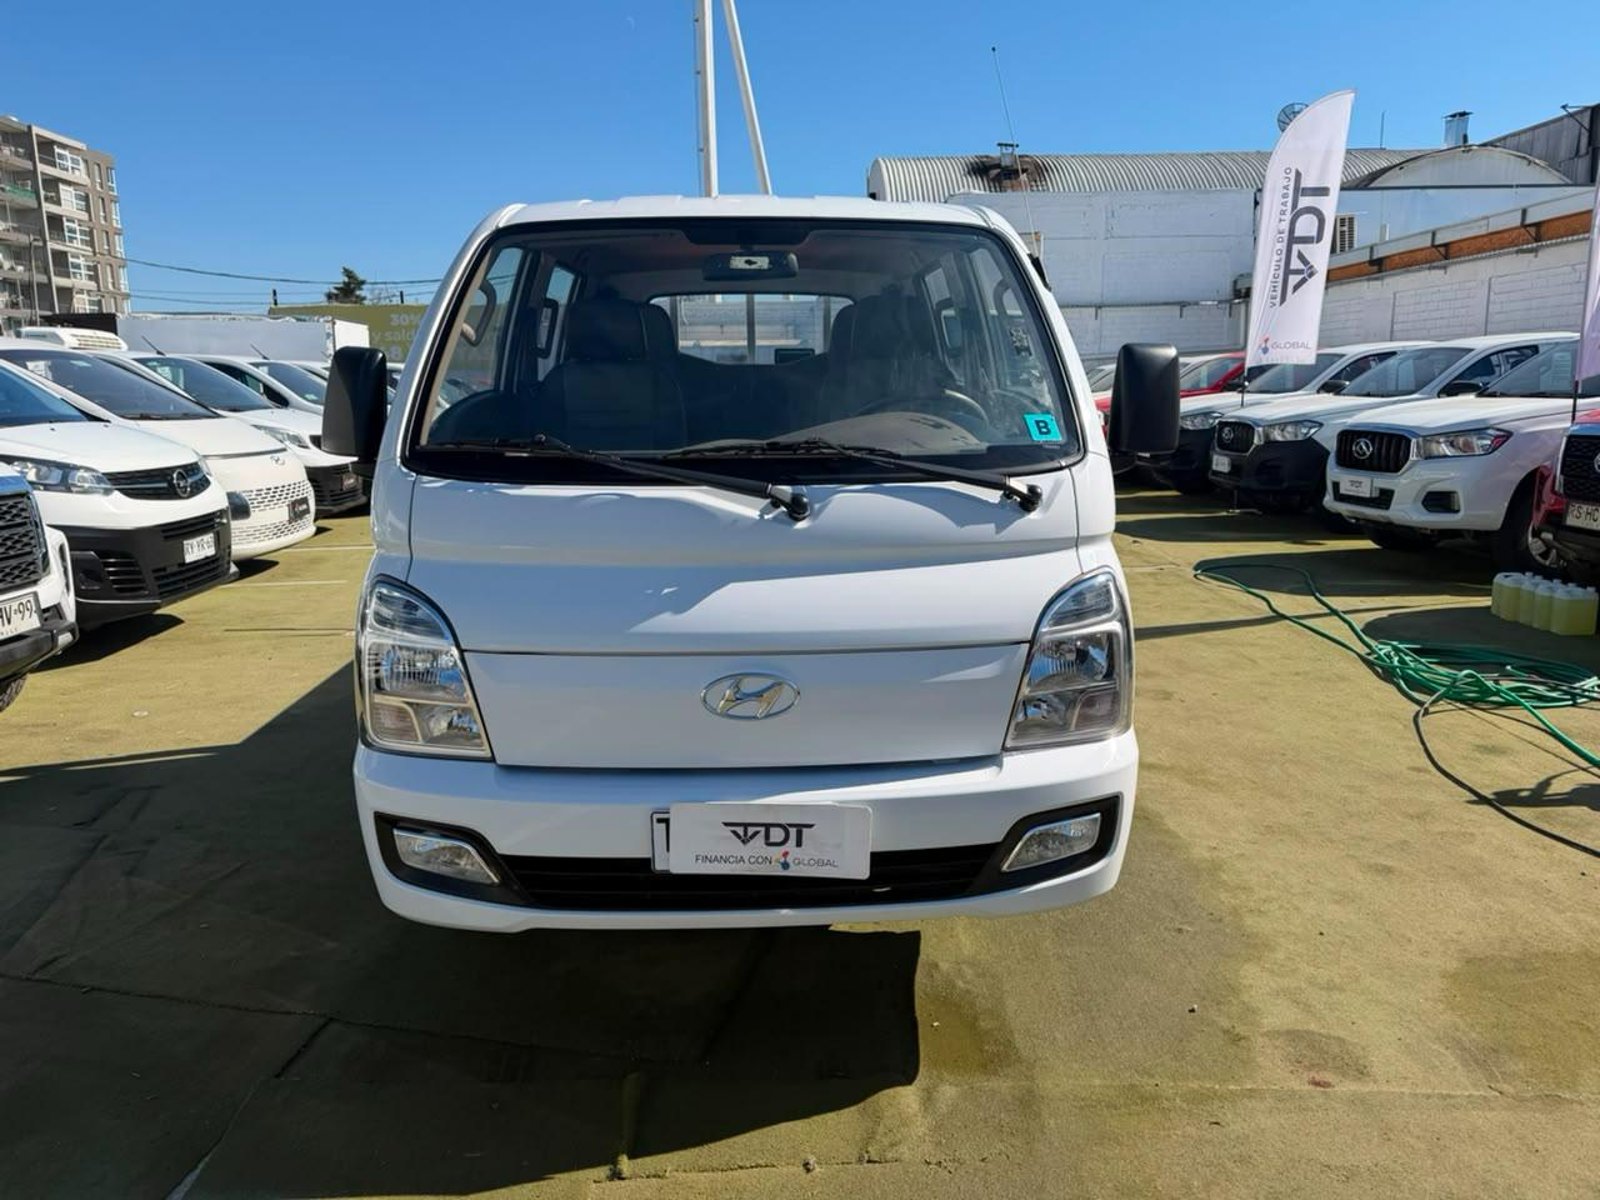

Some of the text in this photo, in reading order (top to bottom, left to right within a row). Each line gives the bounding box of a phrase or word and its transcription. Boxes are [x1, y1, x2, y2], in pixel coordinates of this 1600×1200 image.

[1269, 166, 1292, 308] VEHÍCULO DE TRABAJO
[1271, 340, 1312, 350] GLOBAL
[1034, 419, 1052, 436] B
[694, 854, 839, 868] FINANCIA CON GLOBAL
